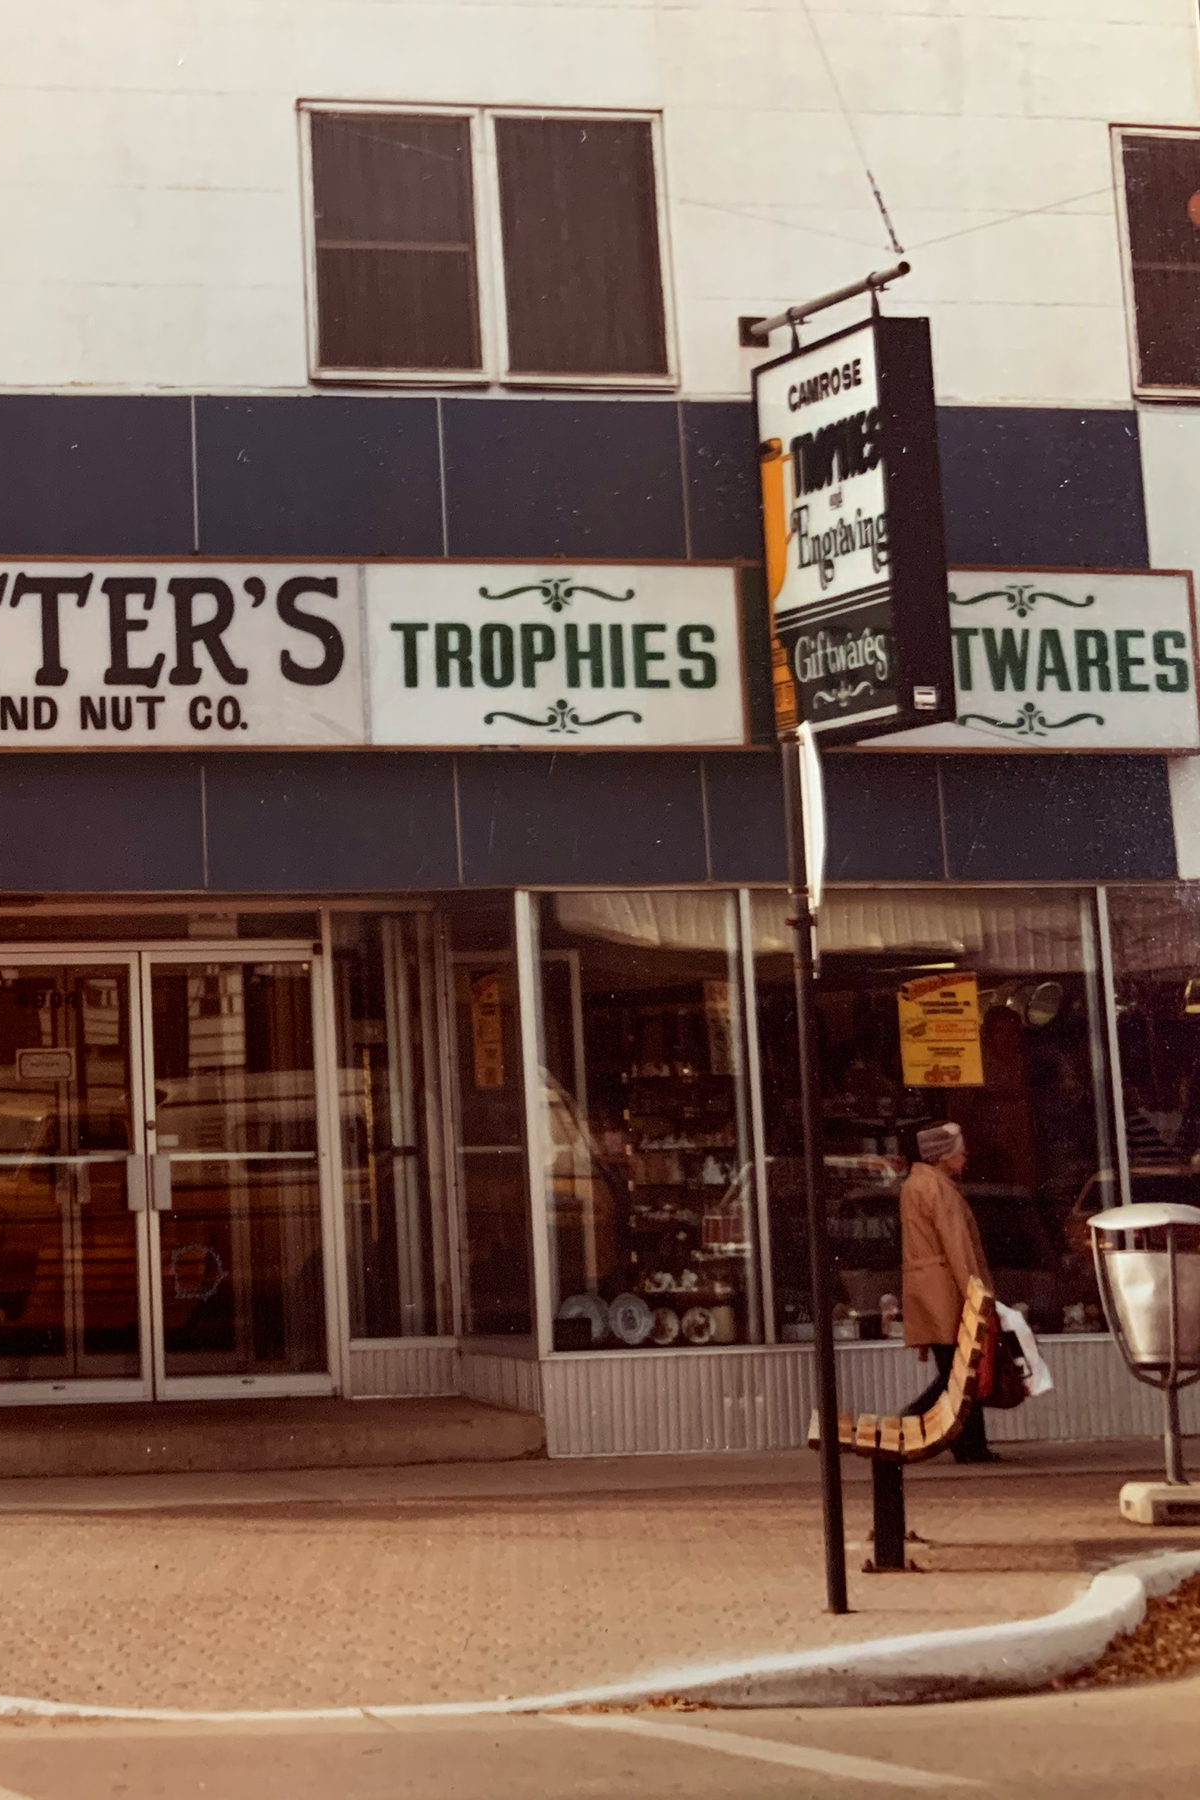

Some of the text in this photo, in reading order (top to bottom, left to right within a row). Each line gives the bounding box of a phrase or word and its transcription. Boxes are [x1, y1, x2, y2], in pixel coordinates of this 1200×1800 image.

[788, 358, 862, 412] CAMROSE
[791, 505, 890, 590] Engraving
[390, 622, 717, 690] TROPHIES
[794, 627, 888, 683] Giftwares
[79, 695, 166, 732] NUT
[188, 695, 249, 732] CO.
